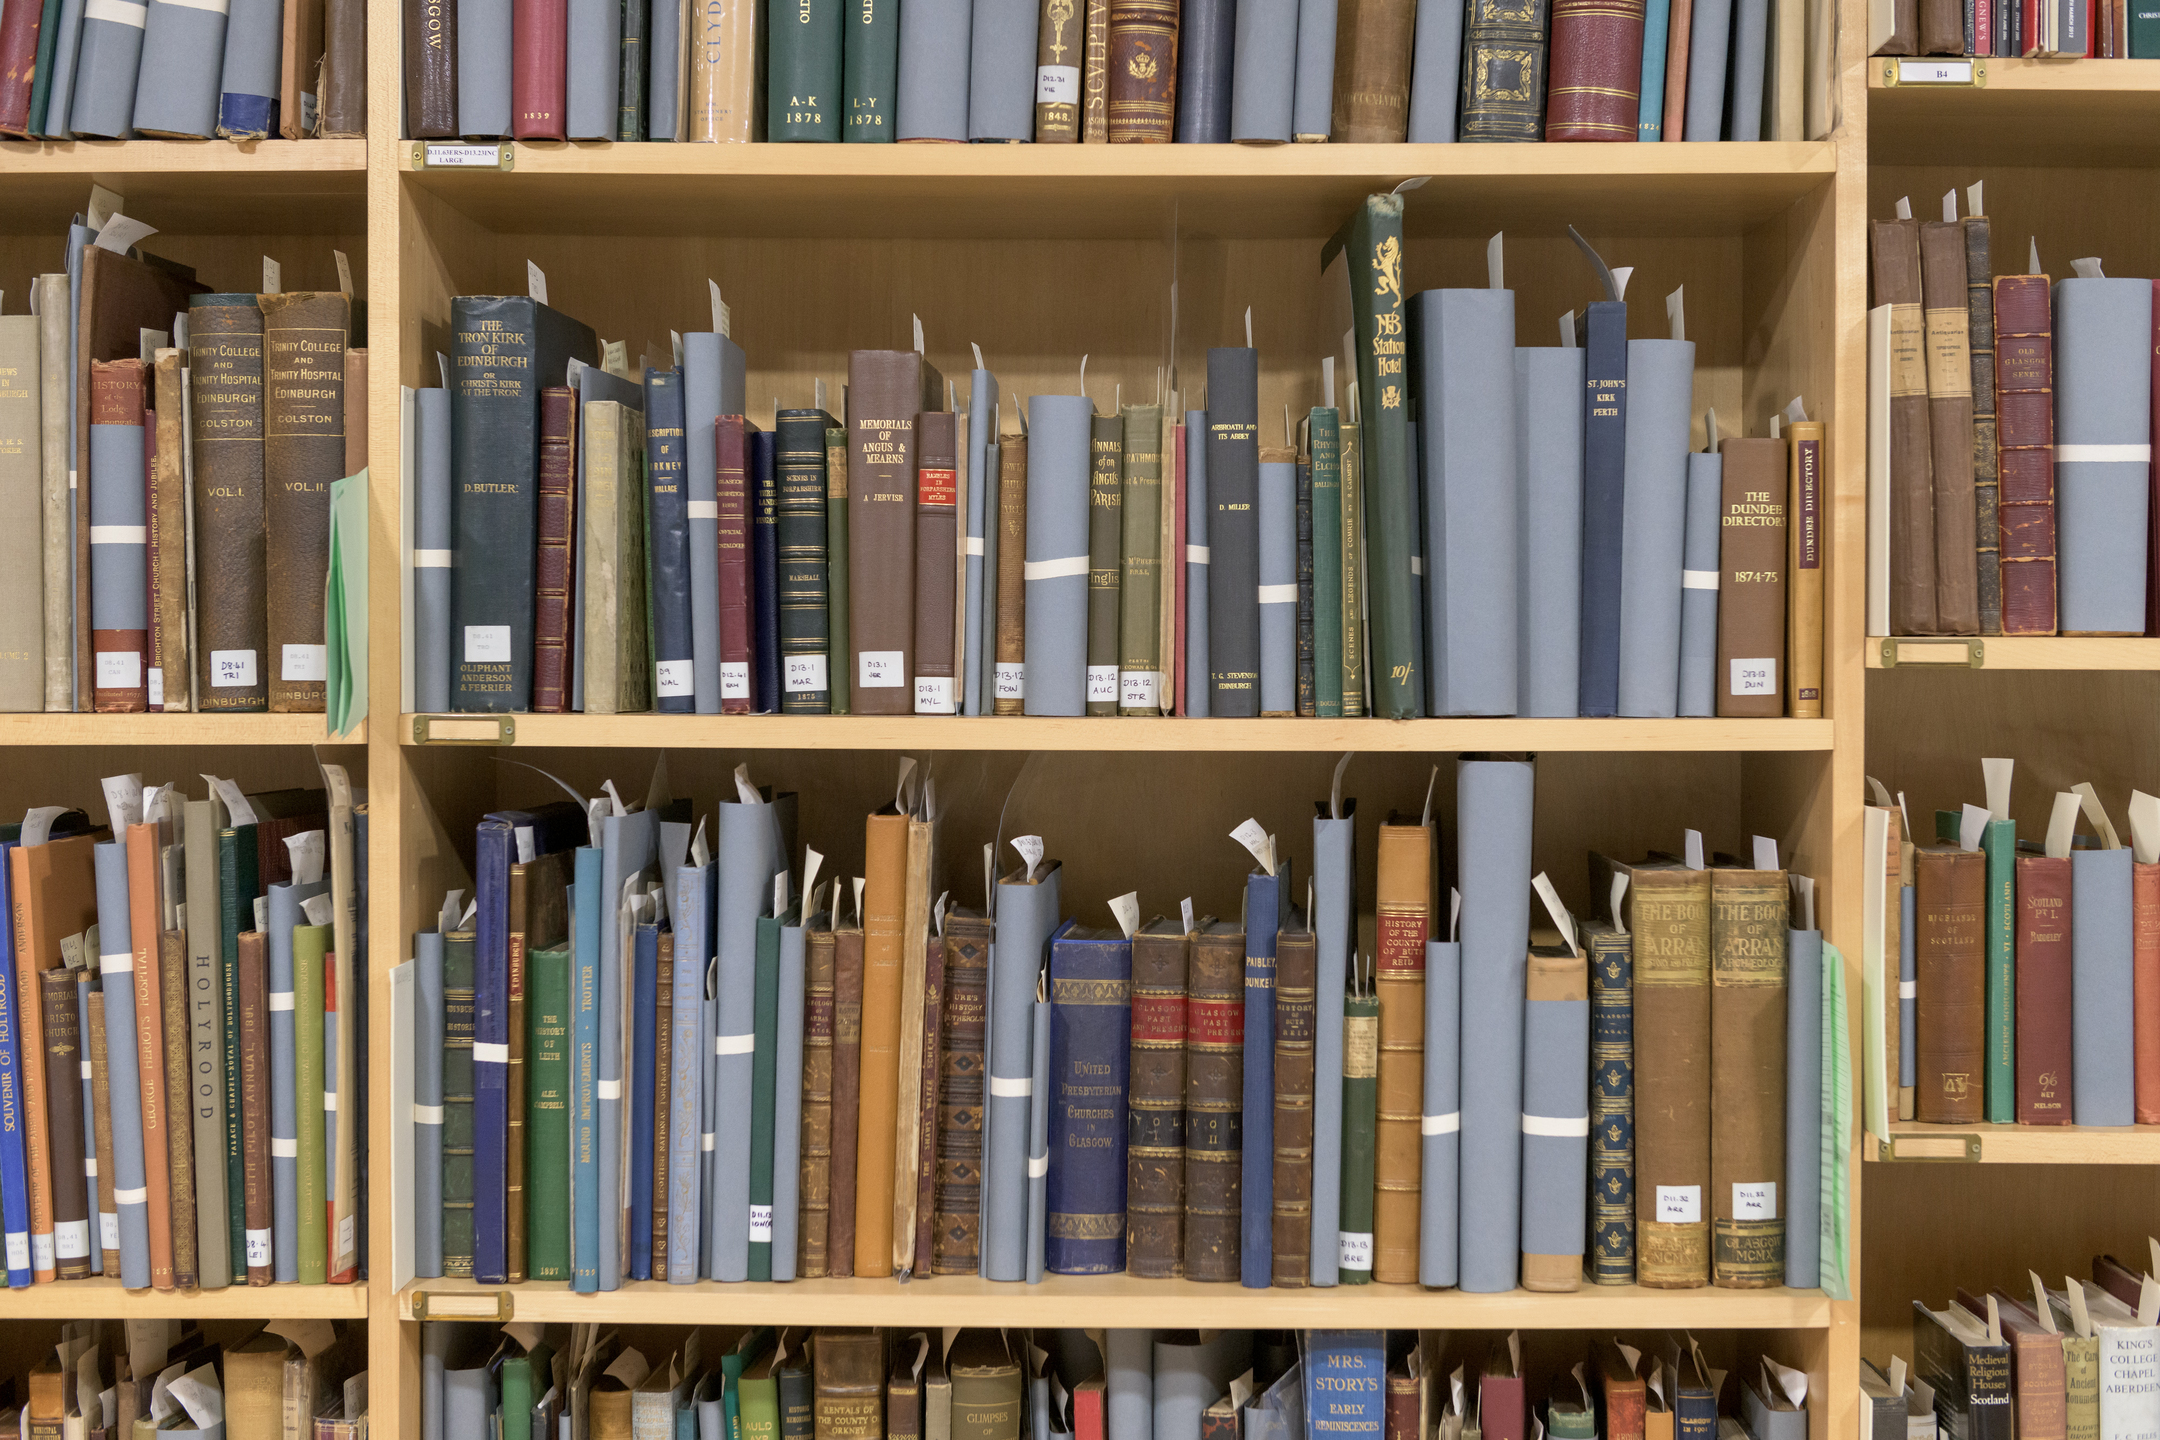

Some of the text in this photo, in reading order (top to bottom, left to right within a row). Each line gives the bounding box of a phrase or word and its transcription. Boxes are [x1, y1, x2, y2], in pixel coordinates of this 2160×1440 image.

[1937, 70, 1947, 78] B4
[786, 113, 821, 124] 1878
[849, 114, 882, 125] 1878
[480, 320, 503, 331] THE
[459, 333, 525, 344] TRON KIRK
[192, 345, 260, 357] TRINITY COLLEGE
[271, 340, 341, 352] TRINITY COLLEGE
[481, 345, 497, 355] OF
[1373, 338, 1405, 355] Station
[457, 356, 527, 368] EDINBURGH
[1378, 357, 1402, 376] Hotel
[192, 374, 262, 385] TRINITY HOSPITAL
[270, 369, 343, 381] TRINITY HOSPITAL
[461, 380, 496, 388] CHRIST'S
[197, 393, 256, 404] EDINBURGH
[275, 388, 336, 399] EDINBURGH
[1597, 394, 1616, 402] KIRK
[102, 404, 128, 414] Lodge
[1593, 408, 1618, 416] PERTH
[200, 419, 253, 428] COLSTON
[278, 415, 332, 424] COLSTON
[860, 420, 912, 429] MEMORIALS
[879, 431, 891, 440] OF
[1319, 428, 1335, 437] THE
[661, 445, 669, 454] OF
[862, 443, 906, 453] ANGUS &
[1091, 438, 1121, 453] ANNALS
[866, 454, 904, 464] MEARNS
[1092, 471, 1118, 486] ANGUS
[285, 482, 327, 492] VOL.II.
[654, 485, 677, 493] WALLACE
[208, 488, 245, 497] VOL.I.
[1745, 492, 1770, 502] THE
[873, 494, 904, 502] JERVISE
[1731, 504, 1782, 515] DUNDEE
[1805, 447, 1815, 562] DUNDEE DIRECTORY
[1735, 571, 1778, 583] 1874-75
[460, 664, 511, 672] OLIPHANT
[461, 674, 512, 682] ANDERSON
[1390, 662, 1414, 685] 10/-
[460, 684, 512, 692] & FERRIER
[1093, 685, 1114, 694] AUC
[1218, 682, 1252, 690] EDINBURGH
[2028, 896, 2063, 909] SCOTLAND
[1928, 914, 1976, 922] HIGHLANDS
[1385, 920, 1422, 928] HISTORY
[1670, 925, 1686, 934] OF
[1747, 925, 1763, 934] OF
[1948, 926, 1957, 934] OF
[1931, 937, 1975, 945] SCOTLAND
[2030, 931, 2061, 944] BADDELEY
[2004, 942, 2011, 952] VI
[511, 942, 519, 988] EDINBURGH
[2003, 963, 2011, 1021] MONUMENTS
[954, 993, 978, 1002] URE'S
[1137, 1005, 1182, 1013] GLASGOW
[1194, 1009, 1239, 1017] GLASGOW
[1277, 1004, 1312, 1012] HISTORY
[543, 1015, 557, 1023] THE
[1203, 1019, 1228, 1027] PAST
[196, 955, 213, 1118] HOLYROOD
[544, 1040, 555, 1048] OF
[2002, 1025, 2010, 1067] ANCIENT
[1, 1049, 10, 1065] OF
[539, 1052, 560, 1061] LEITH
[581, 965, 592, 1164] MOUND IMPROVEMENTS TROTTER
[1074, 1061, 1111, 1075] UNITED
[541, 1090, 559, 1098] ALEX.
[1061, 1083, 1122, 1096] PRESBYTERIAN
[3, 1071, 15, 1132] SOUVENIR
[1068, 1106, 1114, 1119] CHURCHES
[1068, 1134, 1114, 1148] GLASGOW.
[1725, 1237, 1781, 1248] GLASGOW
[1736, 1249, 1775, 1261] MCMX
[2116, 1340, 2153, 1350] KING'S
[1327, 1355, 1367, 1369] MRS.
[1969, 1354, 2008, 1365] Medieval
[2110, 1354, 2158, 1365] COLLEGE
[1969, 1366, 2009, 1380] Religious
[2114, 1369, 2155, 1379] CHAPEL
[1316, 1378, 1378, 1391] STORY'S
[1972, 1379, 2006, 1389] Houses
[2070, 1378, 2097, 1389] Ancient
[1970, 1393, 2009, 1405] Scotland
[823, 1405, 874, 1415] RENTALS OF
[1330, 1404, 1365, 1415] EARLY
[966, 1412, 1008, 1424] GLIMPSES
[1680, 1417, 1712, 1425] GLASGOW
[745, 1422, 772, 1431] AULD
[832, 1426, 866, 1435] ORKNEY
[982, 1427, 992, 1435] OF
[1315, 1421, 1379, 1432] REMINISCENCES
